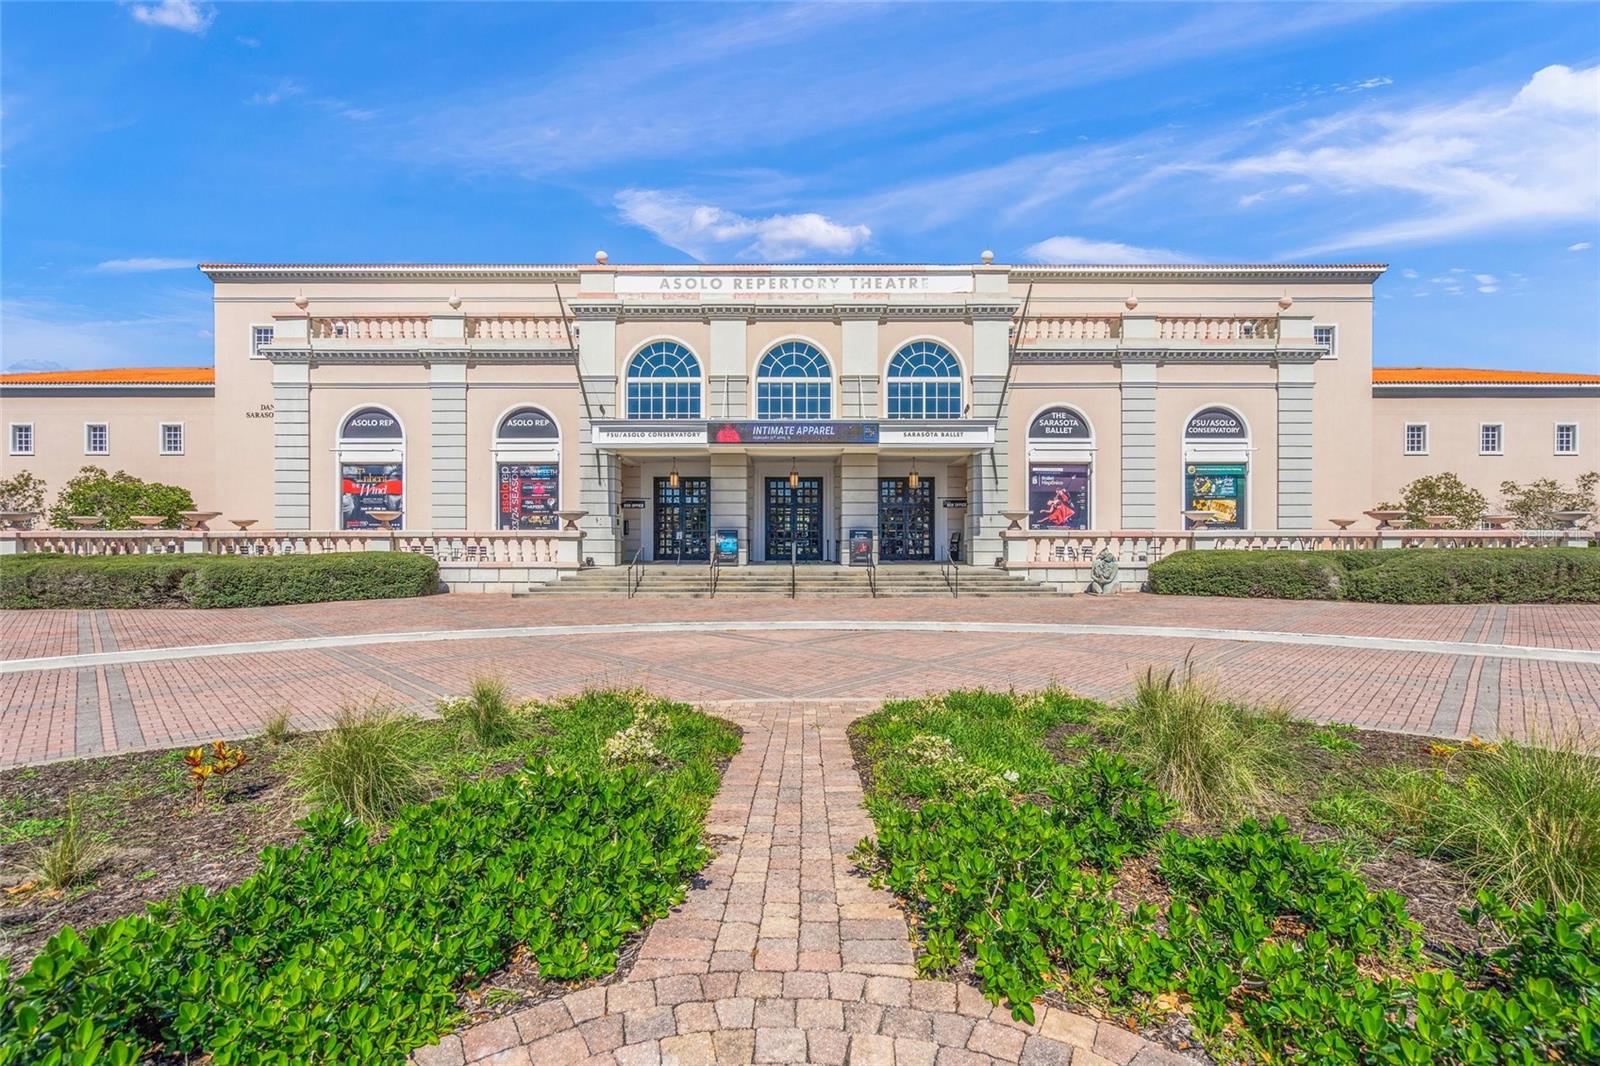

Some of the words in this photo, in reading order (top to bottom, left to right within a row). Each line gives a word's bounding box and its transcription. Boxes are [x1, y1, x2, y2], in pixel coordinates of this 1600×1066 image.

[660, 277, 723, 290] ASOLO
[733, 277, 840, 290] REPERTORY
[849, 277, 929, 289] THEATRE
[351, 419, 378, 427] ASOLO
[379, 419, 395, 427] REP
[507, 419, 534, 427] ASOLO
[534, 419, 551, 427] REP
[1039, 419, 1079, 427] SARASOTA
[1191, 419, 1236, 427] FSU/ASOLO
[752, 425, 794, 436] INTIMATE
[796, 425, 835, 436] APPAREL
[359, 482, 388, 497] Wind
[501, 466, 511, 513] asolorep
[511, 466, 519, 505] SEASON
